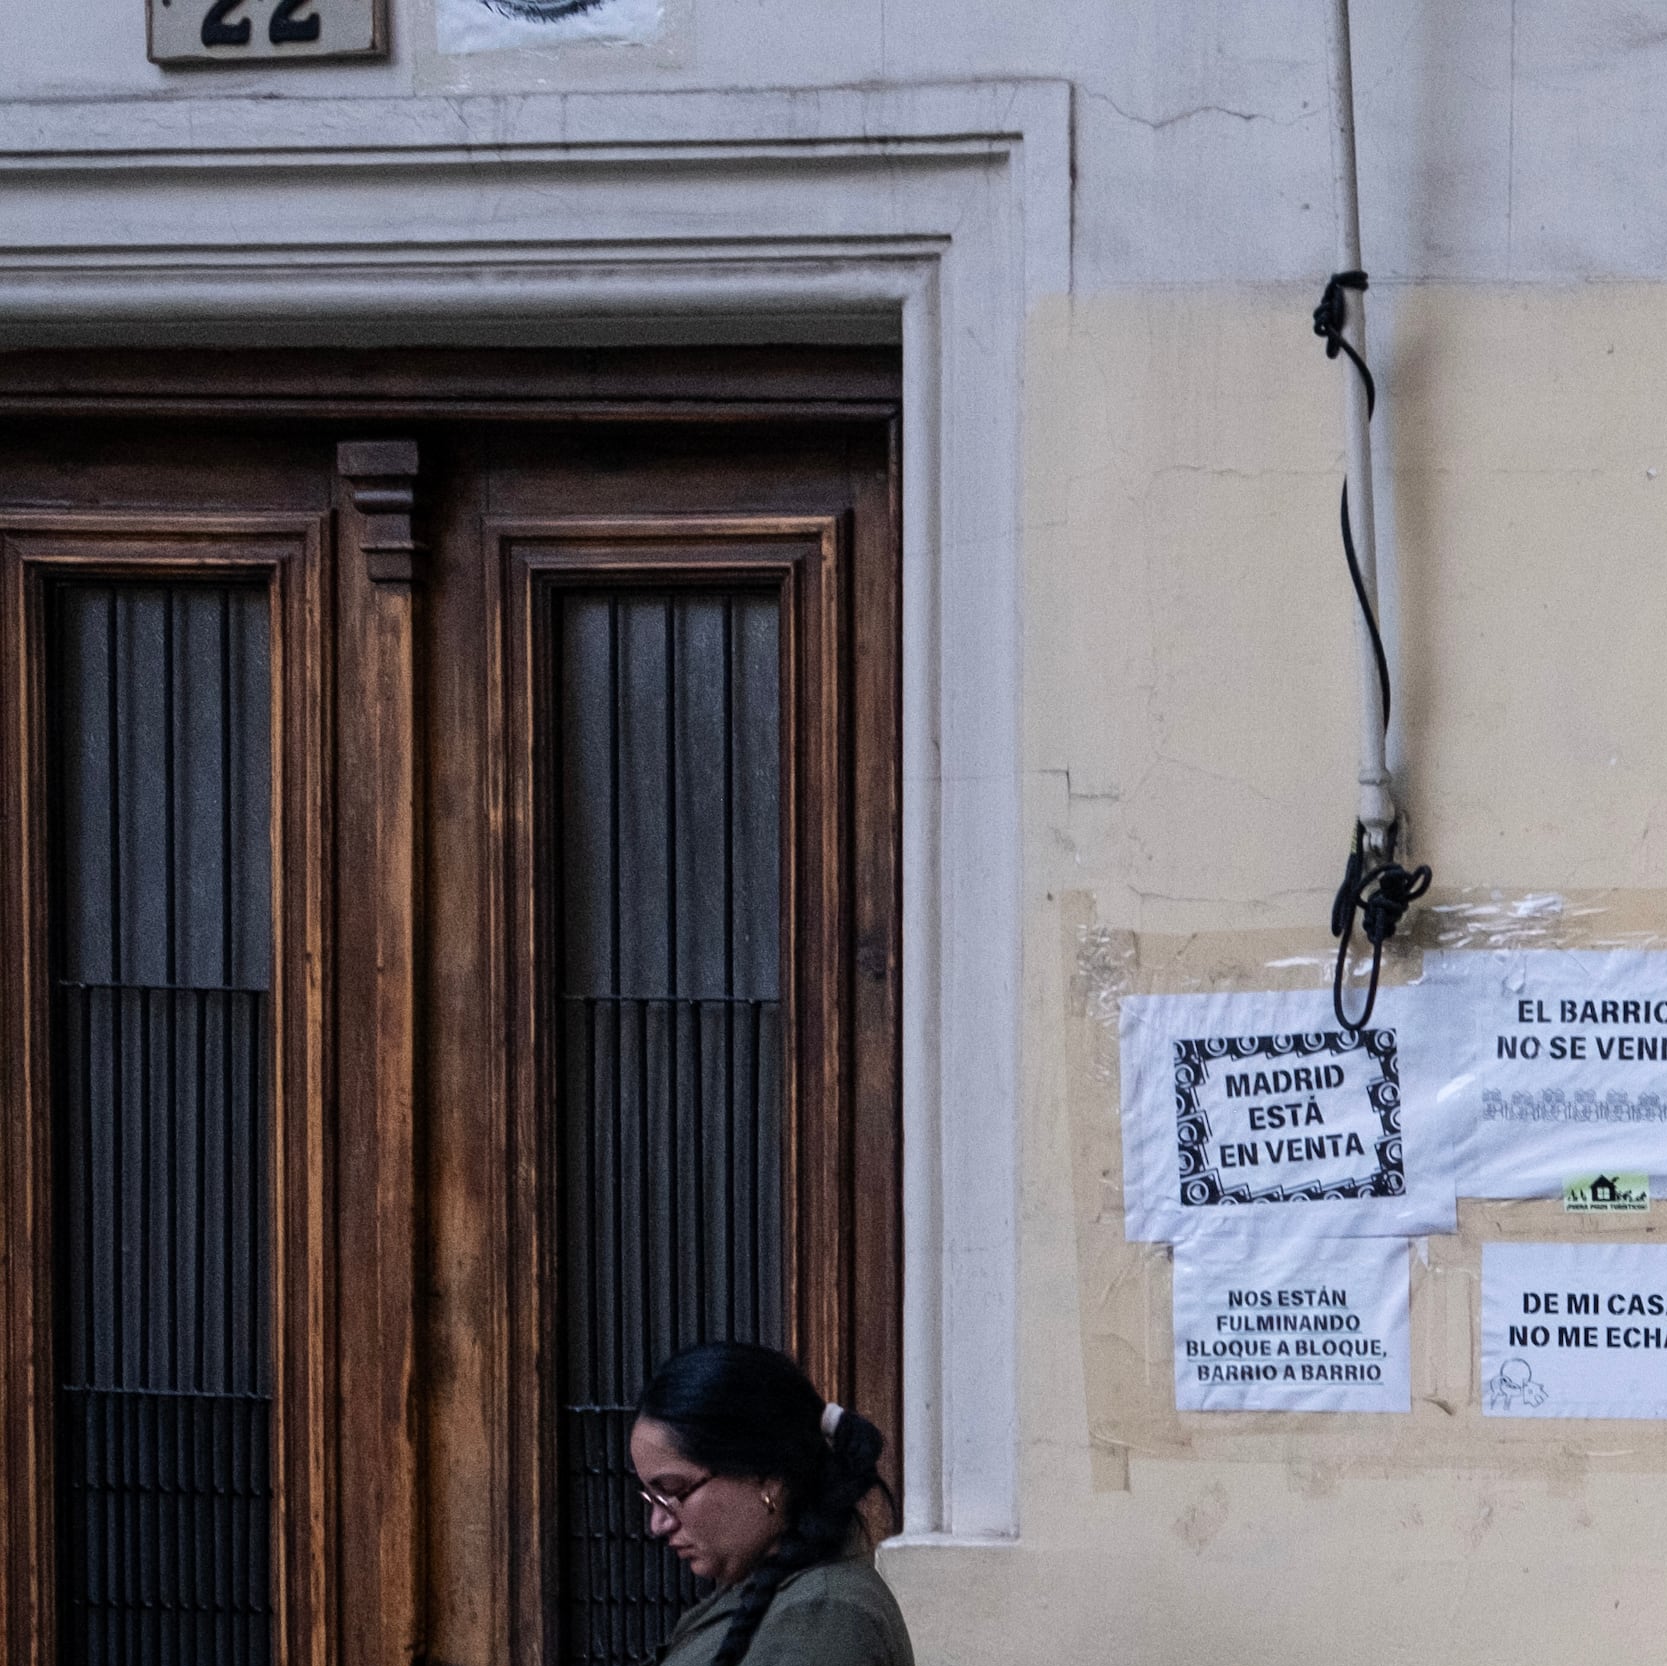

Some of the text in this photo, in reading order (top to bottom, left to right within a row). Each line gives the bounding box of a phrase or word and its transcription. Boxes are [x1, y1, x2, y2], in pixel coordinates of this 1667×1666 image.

[1518, 999, 1552, 1023] EL
[1497, 1035, 1541, 1060] NO
[1549, 1036, 1586, 1060] SE
[1225, 1064, 1345, 1098] MADRID
[1248, 1095, 1324, 1131] ESTÁ
[1219, 1132, 1365, 1169] EN VENTA
[1228, 1285, 1347, 1310] NOS ESTÁN
[1523, 1292, 1559, 1315] DE
[1567, 1293, 1600, 1315] MI
[1216, 1314, 1361, 1332] FULMINANDO
[1509, 1325, 1550, 1347] NO
[1557, 1326, 1599, 1348] ME
[1185, 1339, 1387, 1360] BLOQUE A BLOQUE,
[1197, 1363, 1382, 1382] BARRIO A BARRIO
